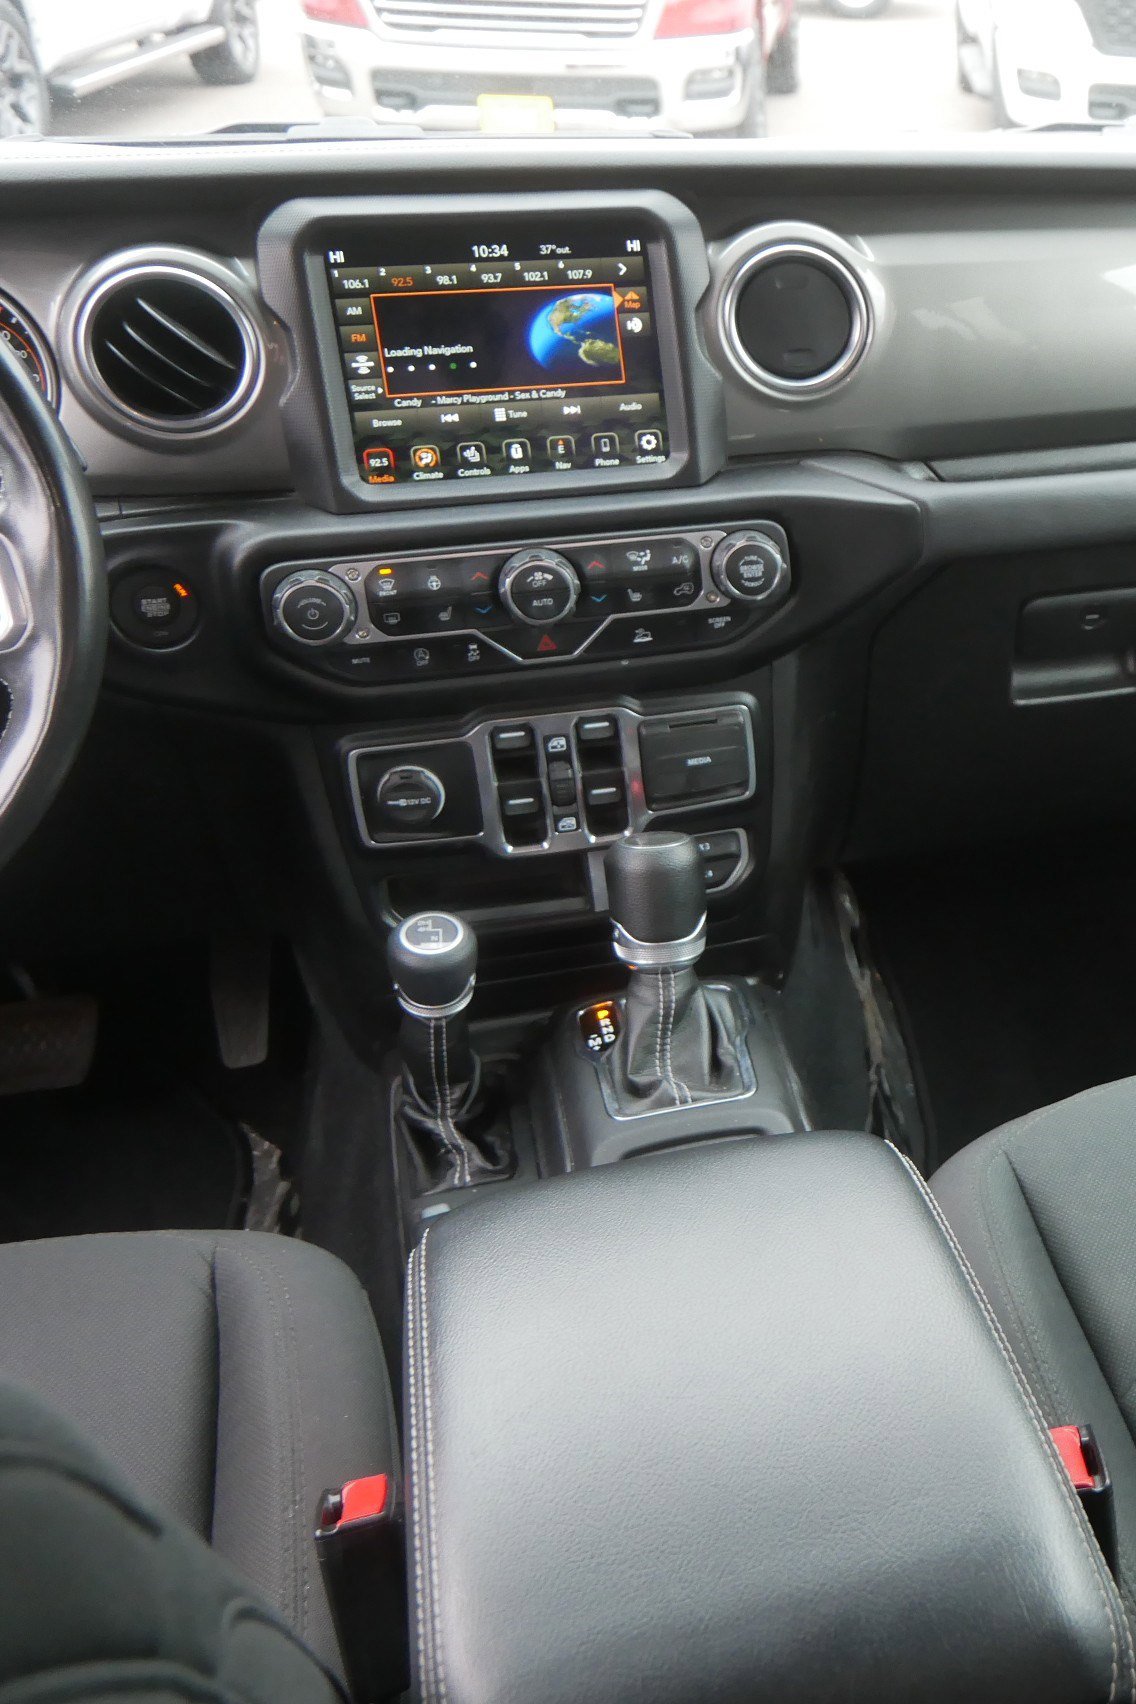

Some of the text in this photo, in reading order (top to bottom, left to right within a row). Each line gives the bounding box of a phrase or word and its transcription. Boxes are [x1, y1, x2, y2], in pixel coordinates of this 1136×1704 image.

[626, 239, 641, 252] HI
[471, 244, 509, 258] 10:34
[328, 250, 345, 263] HI
[469, 264, 477, 273] 4
[514, 262, 521, 271] 5
[557, 260, 565, 269] 6
[332, 269, 339, 278] 1
[379, 267, 386, 276] 2
[425, 265, 432, 275] 3
[567, 269, 593, 280] 107.9
[436, 275, 457, 285] 98.1
[481, 273, 502, 283] 93.7
[523, 271, 548, 281] 102.1
[342, 278, 369, 289] 106.1
[391, 276, 413, 287] 92.5
[625, 301, 641, 310] Map
[346, 306, 362, 316] AM
[351, 333, 366, 343] FM
[384, 344, 473, 358] Loading Navigation
[351, 384, 376, 393] Source
[354, 392, 376, 401] Select
[394, 397, 422, 408] Candy
[436, 395, 462, 406] Marcy
[463, 393, 509, 404] Playground
[515, 390, 530, 400] Sex
[531, 389, 539, 399] &
[540, 388, 567, 399] Candy
[619, 401, 643, 411] Audio
[508, 410, 528, 419] Tune
[372, 419, 403, 428] Browse
[369, 458, 389, 467] 92.5
[594, 457, 620, 467] Phone
[636, 454, 667, 465] Settings
[509, 463, 530, 473] Apps
[555, 461, 572, 470] Nav
[413, 471, 444, 480] Climate
[458, 467, 492, 477] Controls
[369, 475, 395, 484] Media
[671, 555, 689, 565] A/C
[531, 580, 547, 588] OFF
[141, 597, 167, 605] START
[532, 598, 554, 607] AUTO
[687, 756, 712, 767] MEDIA
[602, 1025, 615, 1035] N
[588, 1036, 603, 1048] M
[603, 1033, 616, 1043] D
